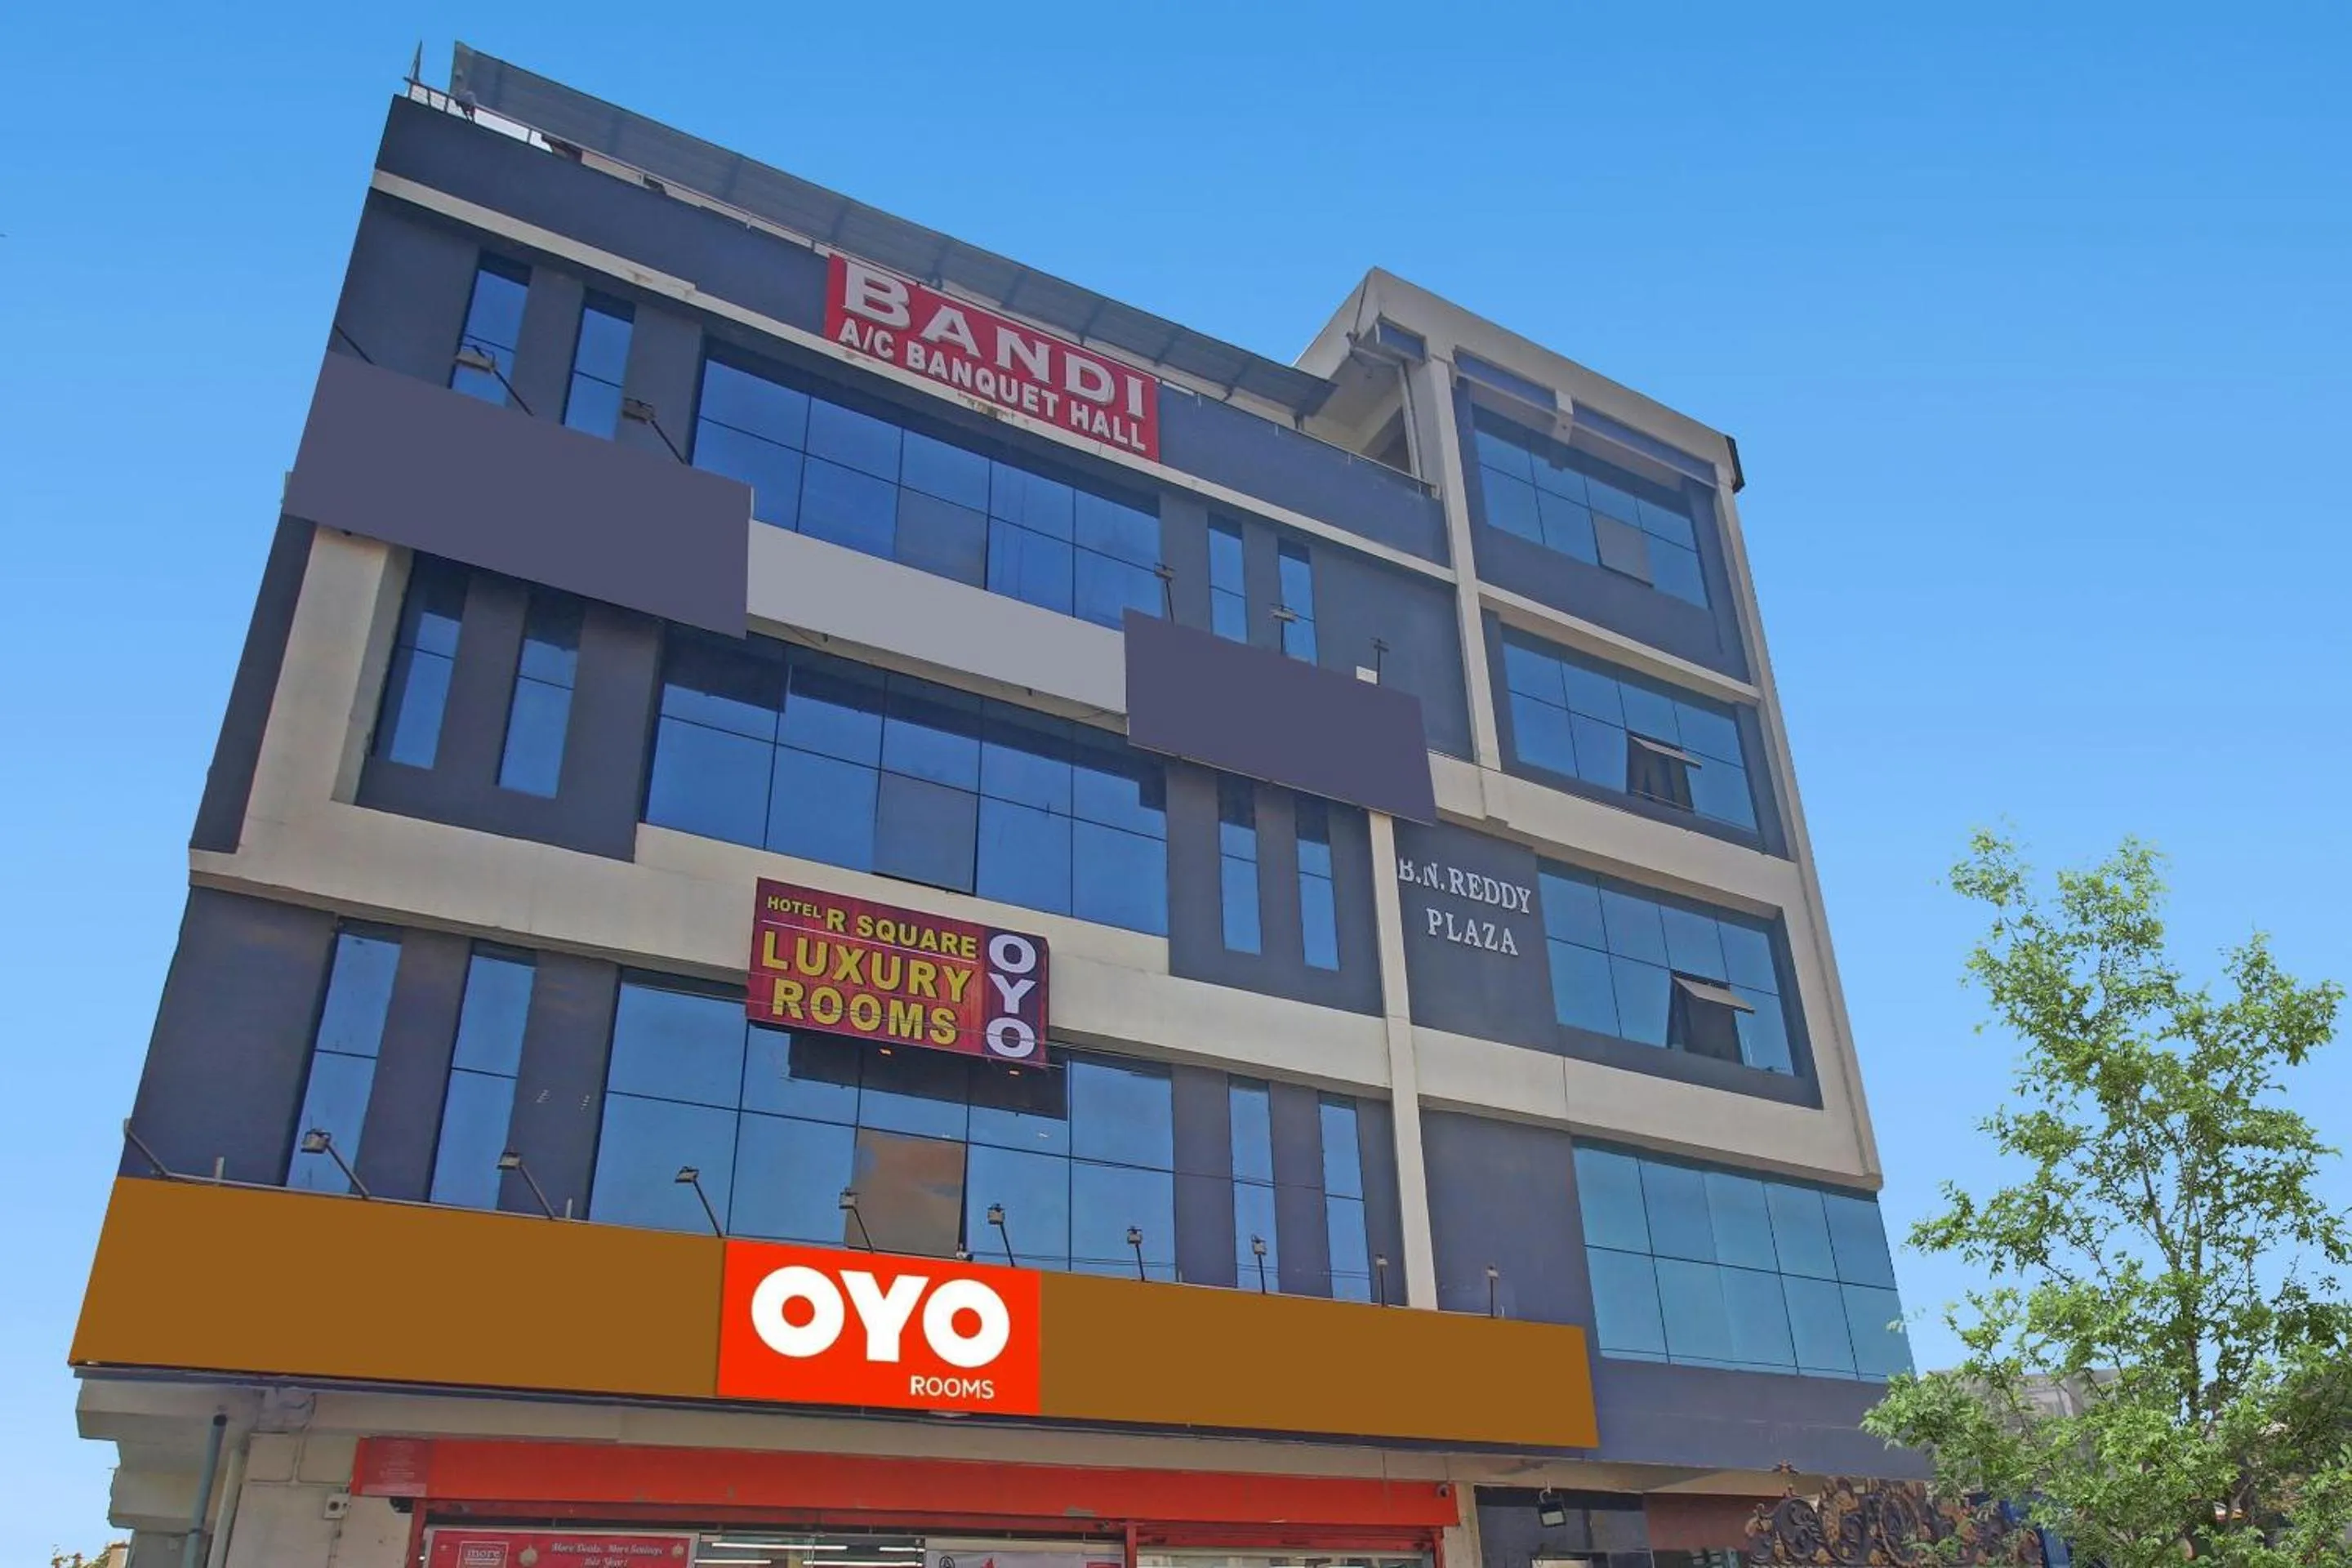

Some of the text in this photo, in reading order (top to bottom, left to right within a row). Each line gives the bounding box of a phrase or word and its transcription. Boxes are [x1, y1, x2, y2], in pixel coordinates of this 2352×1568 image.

[842, 261, 1145, 418] BANDI
[838, 318, 1147, 452] A/C BANQUET HALL
[767, 896, 978, 960] HOTEL R SQUARE
[1426, 907, 1519, 956] PLAZA
[762, 930, 973, 1004] LUXURY
[986, 933, 1037, 1058] OYO
[771, 978, 960, 1046] ROOMS
[751, 1265, 1010, 1368] OYO
[910, 1374, 996, 1400] ROOMS
[467, 1548, 501, 1558] more
